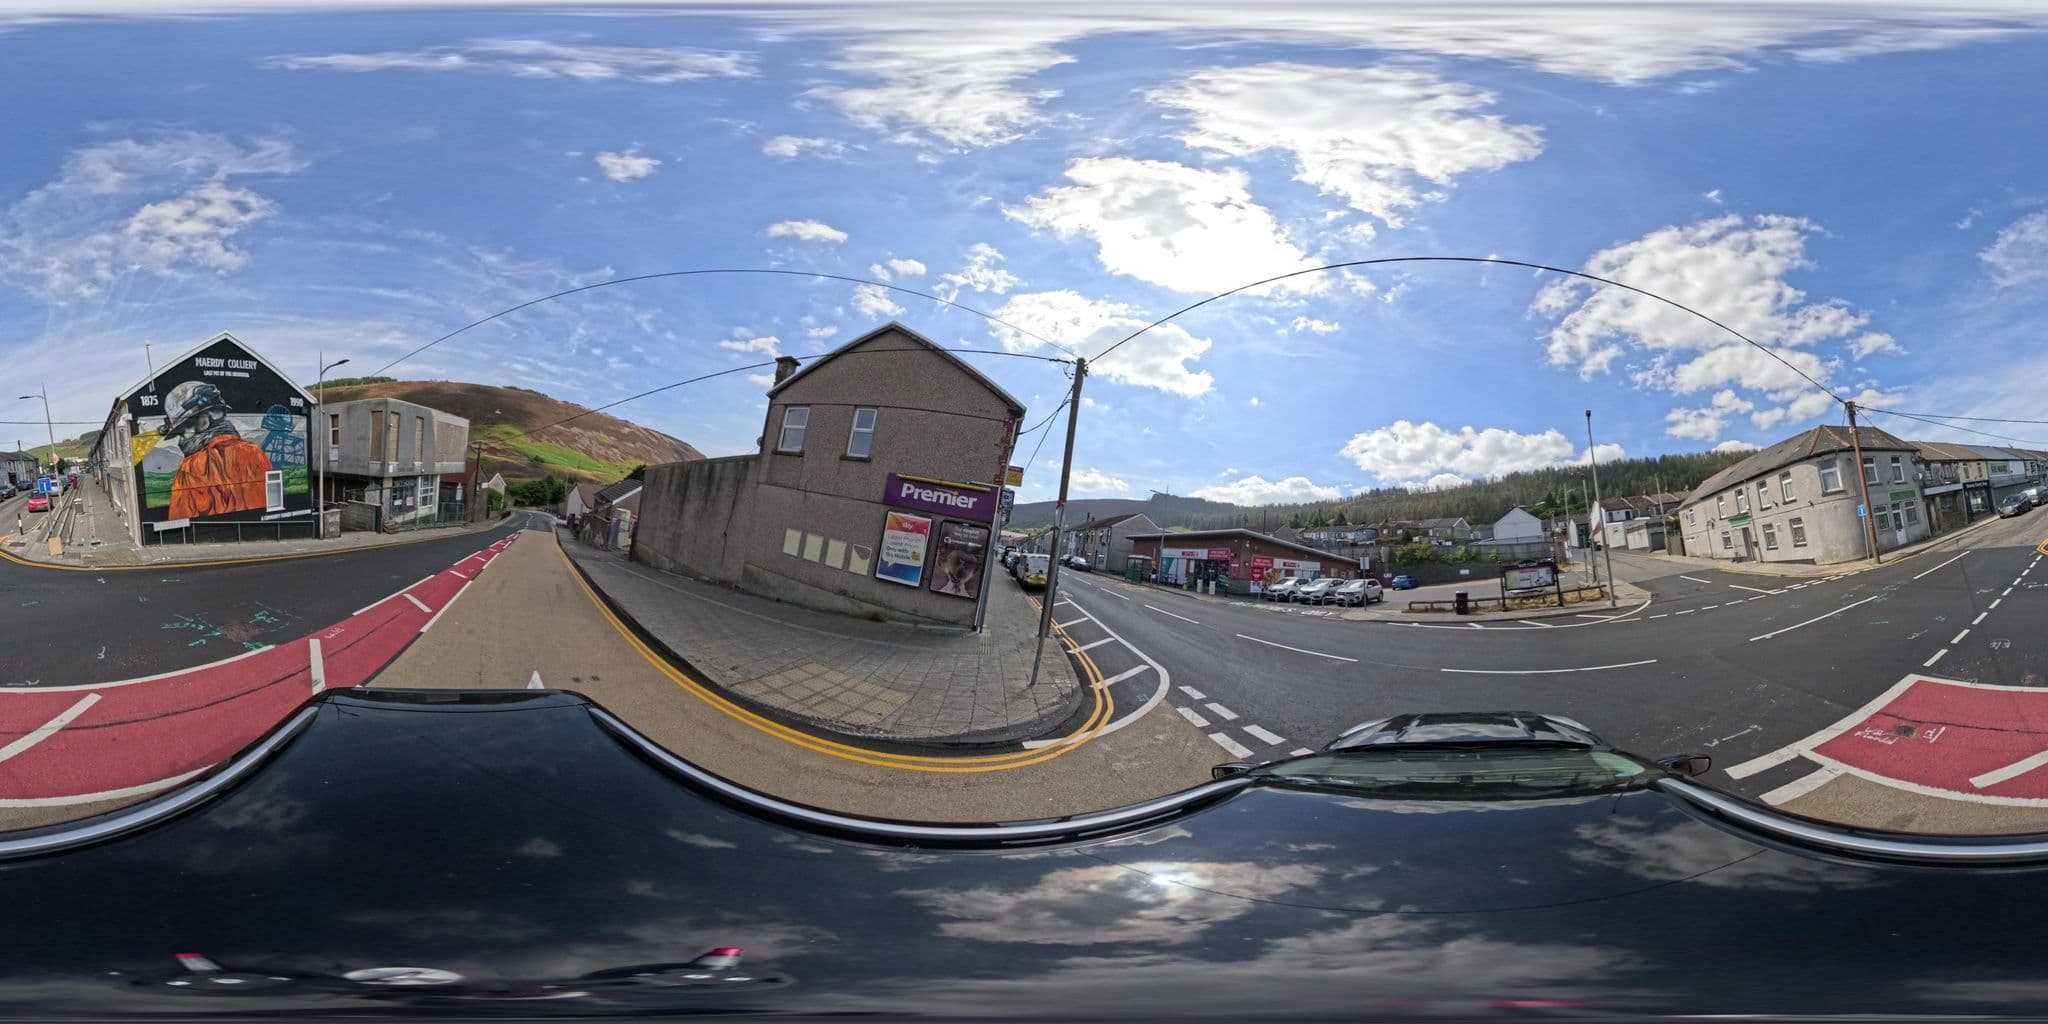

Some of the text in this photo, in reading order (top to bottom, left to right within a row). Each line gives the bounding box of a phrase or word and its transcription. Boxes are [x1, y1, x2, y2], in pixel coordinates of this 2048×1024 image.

[195, 357, 257, 370] MAERDY COLLIERY
[140, 395, 159, 406] 1875
[901, 483, 977, 509] Premier
